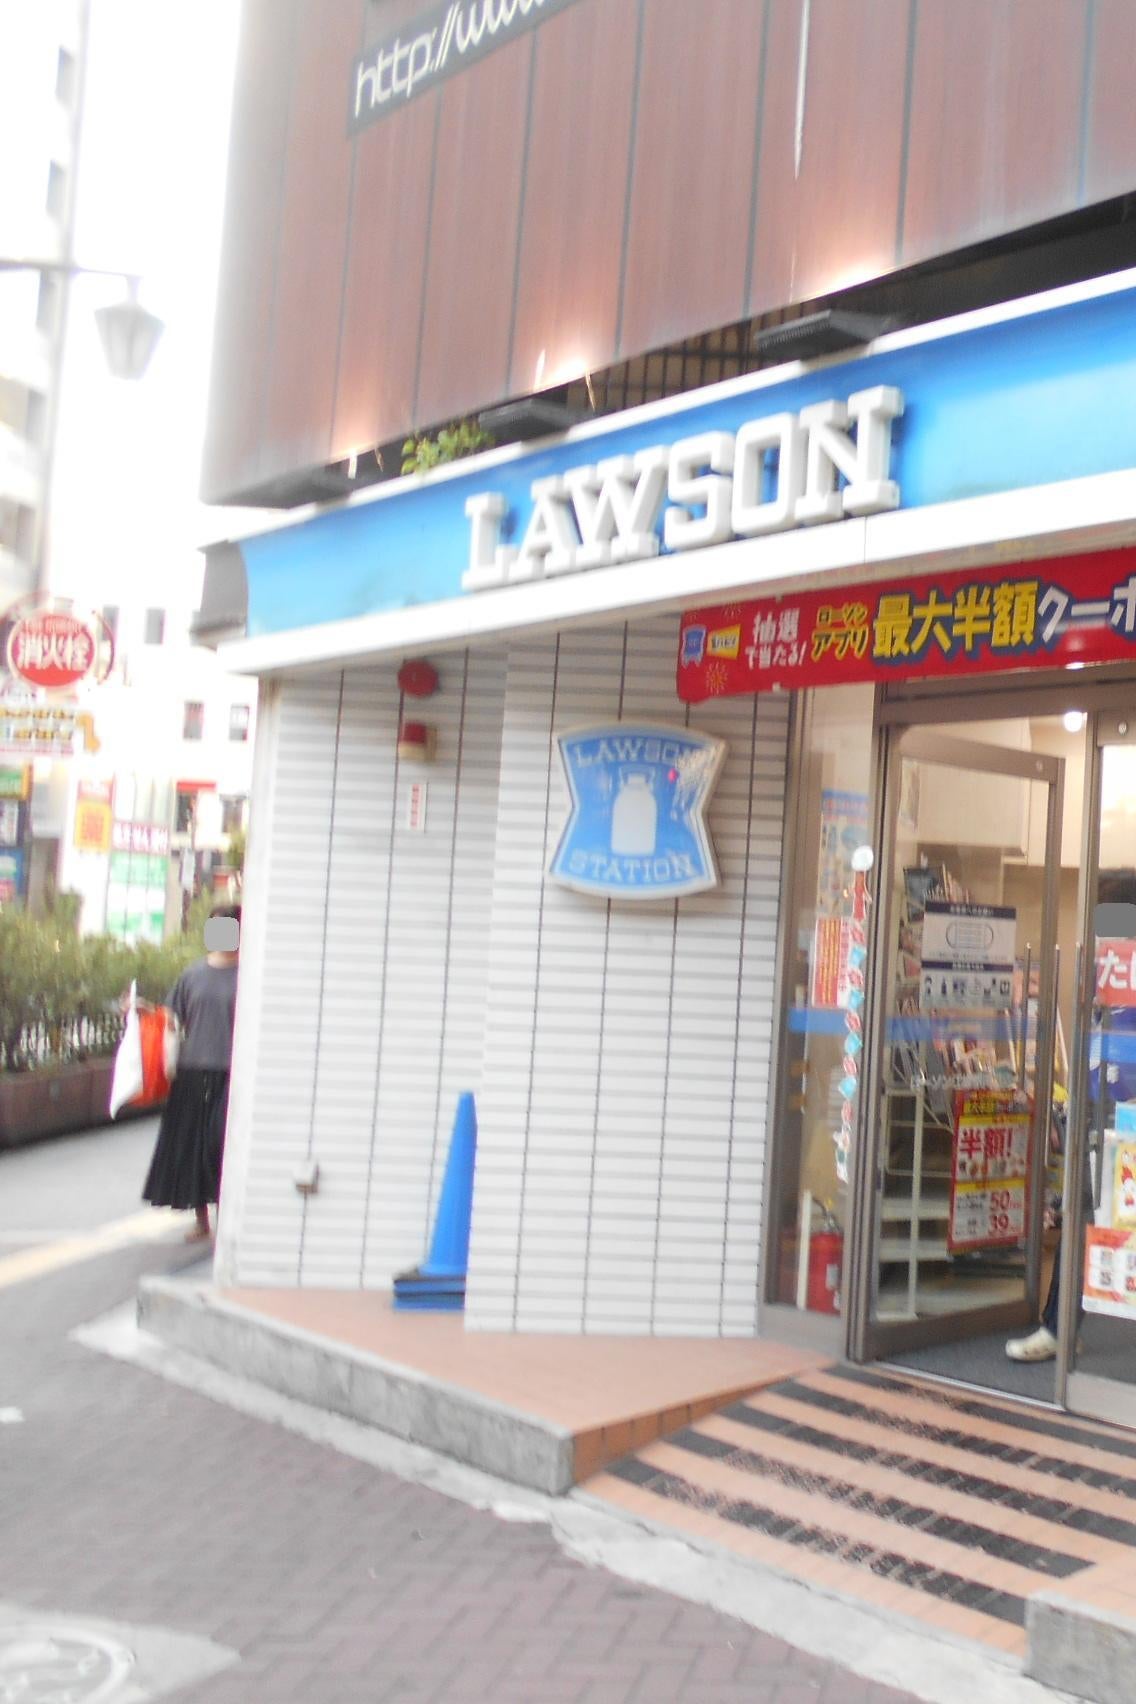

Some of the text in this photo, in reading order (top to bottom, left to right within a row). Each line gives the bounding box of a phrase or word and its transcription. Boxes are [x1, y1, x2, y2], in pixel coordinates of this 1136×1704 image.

[461, 384, 903, 590] LAWSON
[753, 607, 800, 643] 抽選
[811, 625, 869, 661] アプリ
[18, 634, 88, 672] 消火栓
[569, 848, 697, 884] STATION
